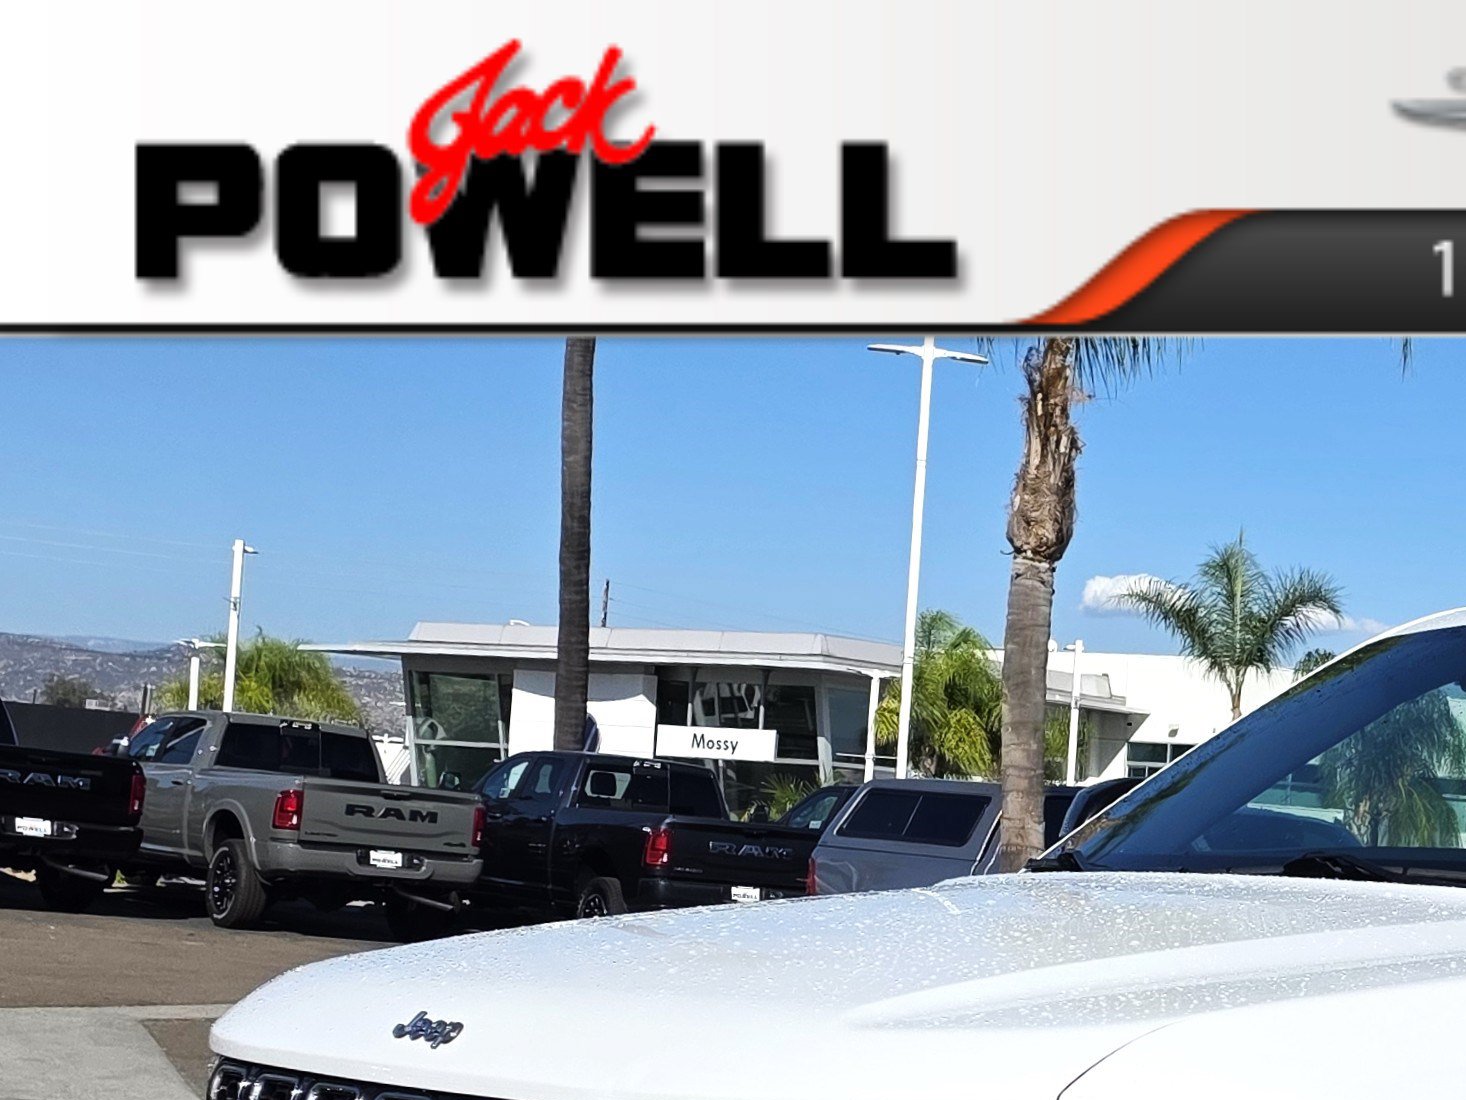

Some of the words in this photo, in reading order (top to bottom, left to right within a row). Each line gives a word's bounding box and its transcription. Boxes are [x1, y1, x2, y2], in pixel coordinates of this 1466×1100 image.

[691, 732, 739, 755] Mossy
[0, 768, 91, 791] RAM
[345, 803, 439, 824] RAM
[709, 840, 793, 859] RAM
[392, 1010, 465, 1050] Jeep
